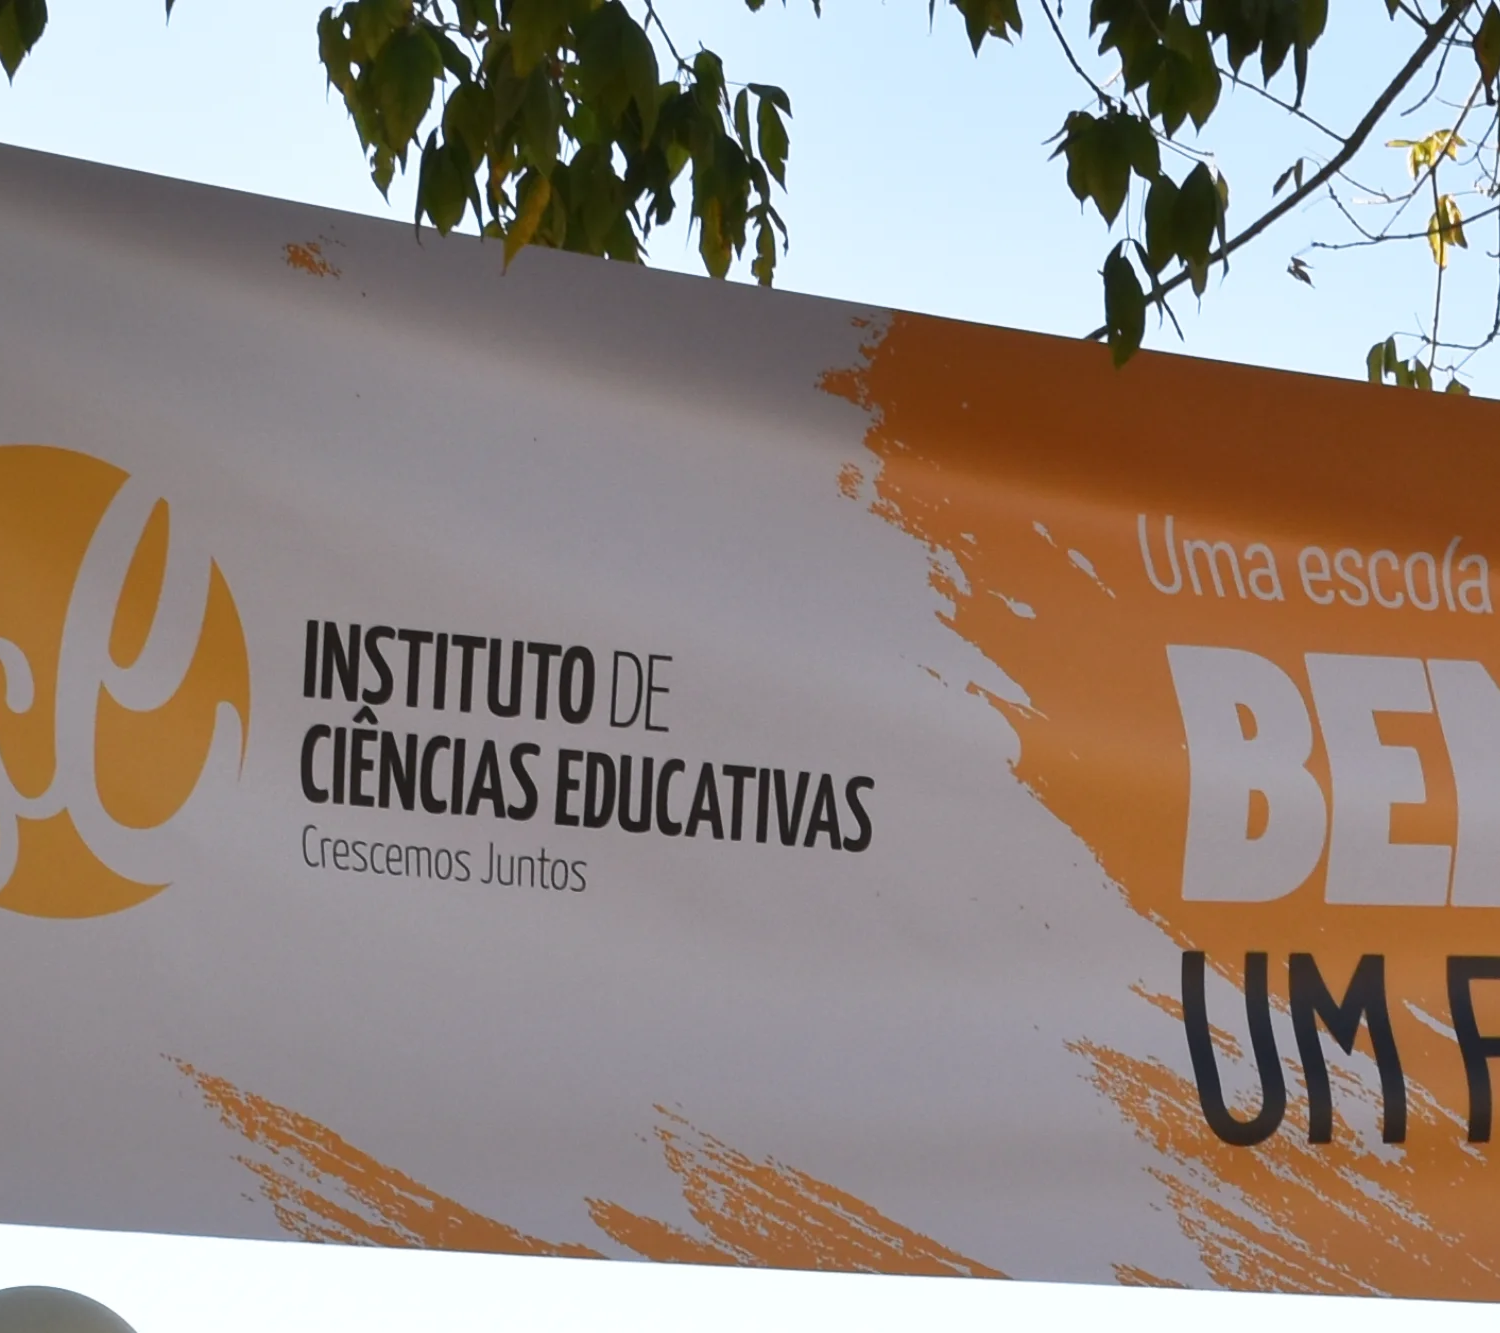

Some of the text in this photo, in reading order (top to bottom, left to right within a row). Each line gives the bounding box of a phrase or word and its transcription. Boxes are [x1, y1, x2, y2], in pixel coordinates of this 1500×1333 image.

[1136, 512, 1284, 603] Uma
[1298, 536, 1491, 616] escola
[302, 620, 675, 733] INSTITUTO DE
[299, 707, 875, 855] CIÊNCIAS EDUCATIVAS
[300, 824, 588, 895] Crescemos Juntos
[1179, 948, 1409, 1147] UM
